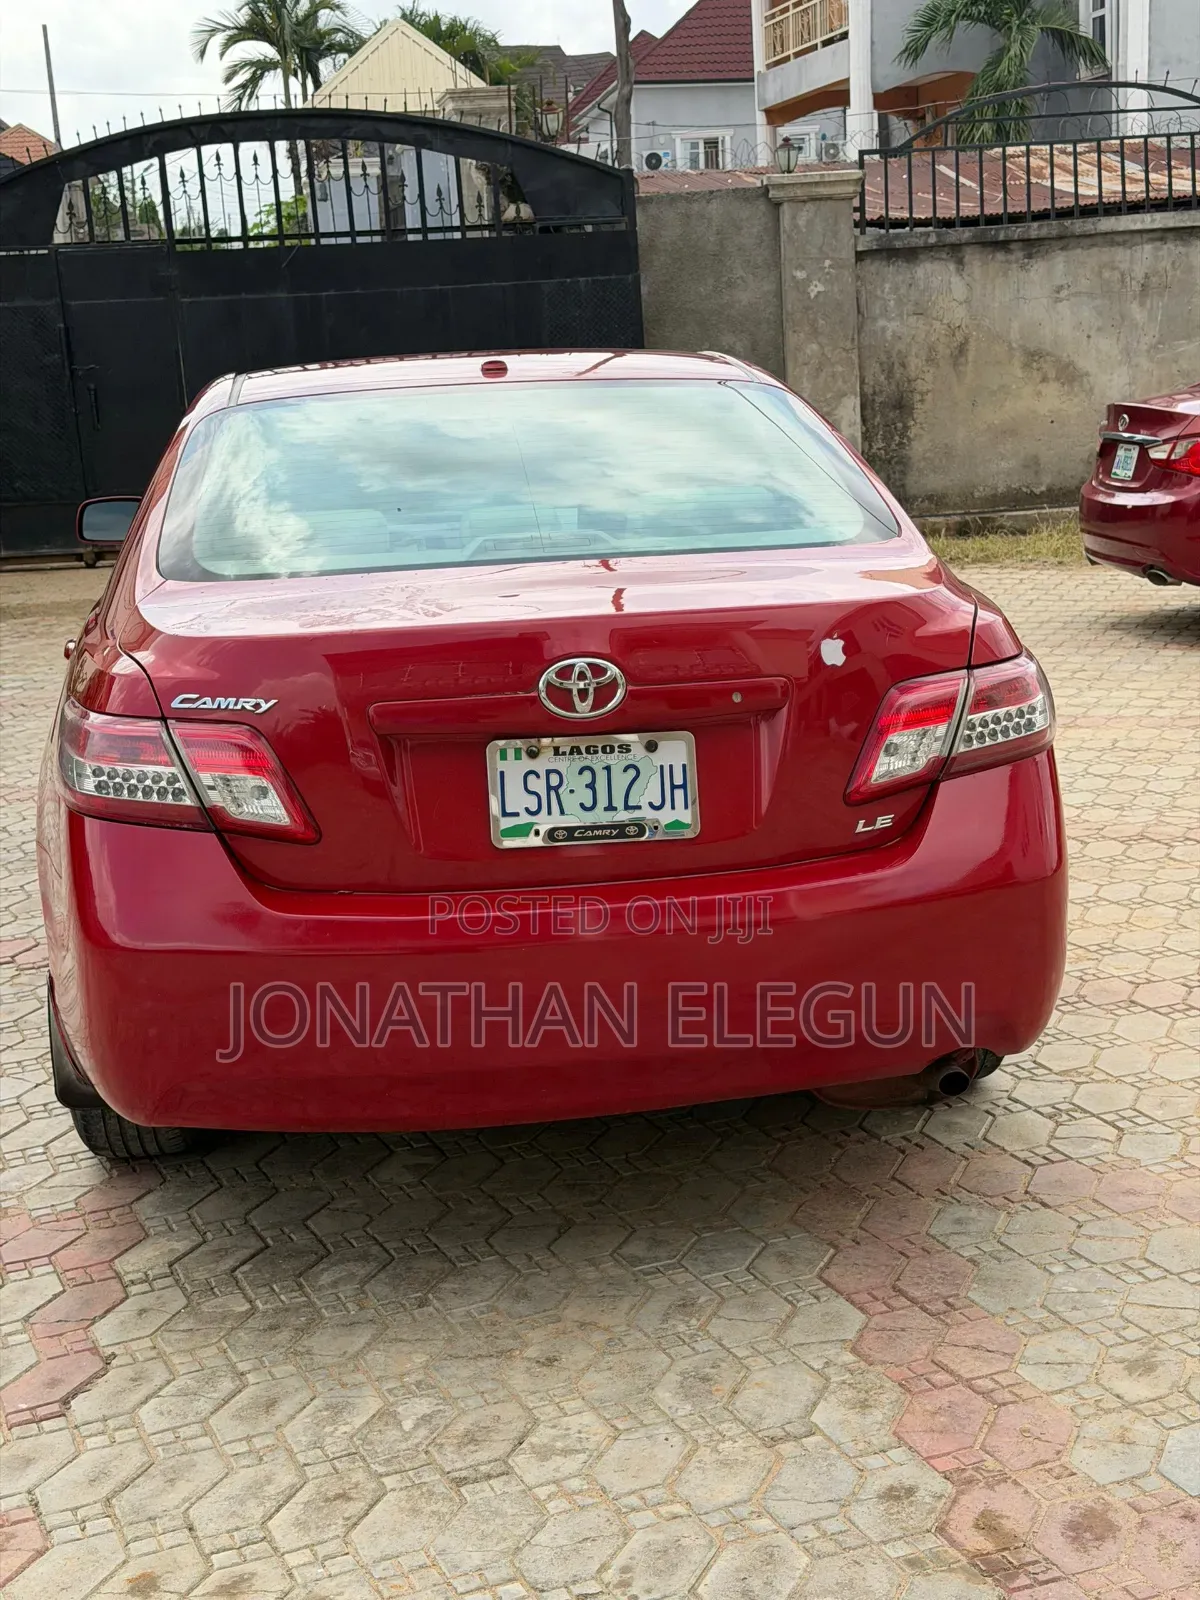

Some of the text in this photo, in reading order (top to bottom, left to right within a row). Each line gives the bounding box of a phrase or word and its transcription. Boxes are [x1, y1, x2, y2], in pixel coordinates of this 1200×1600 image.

[170, 693, 279, 714] CAMRY
[552, 743, 632, 757] LAGOS
[548, 755, 577, 763] CENTRE
[591, 753, 638, 762] EXCELLENCE
[855, 814, 895, 833] LE
[573, 828, 620, 837] CAMRY
